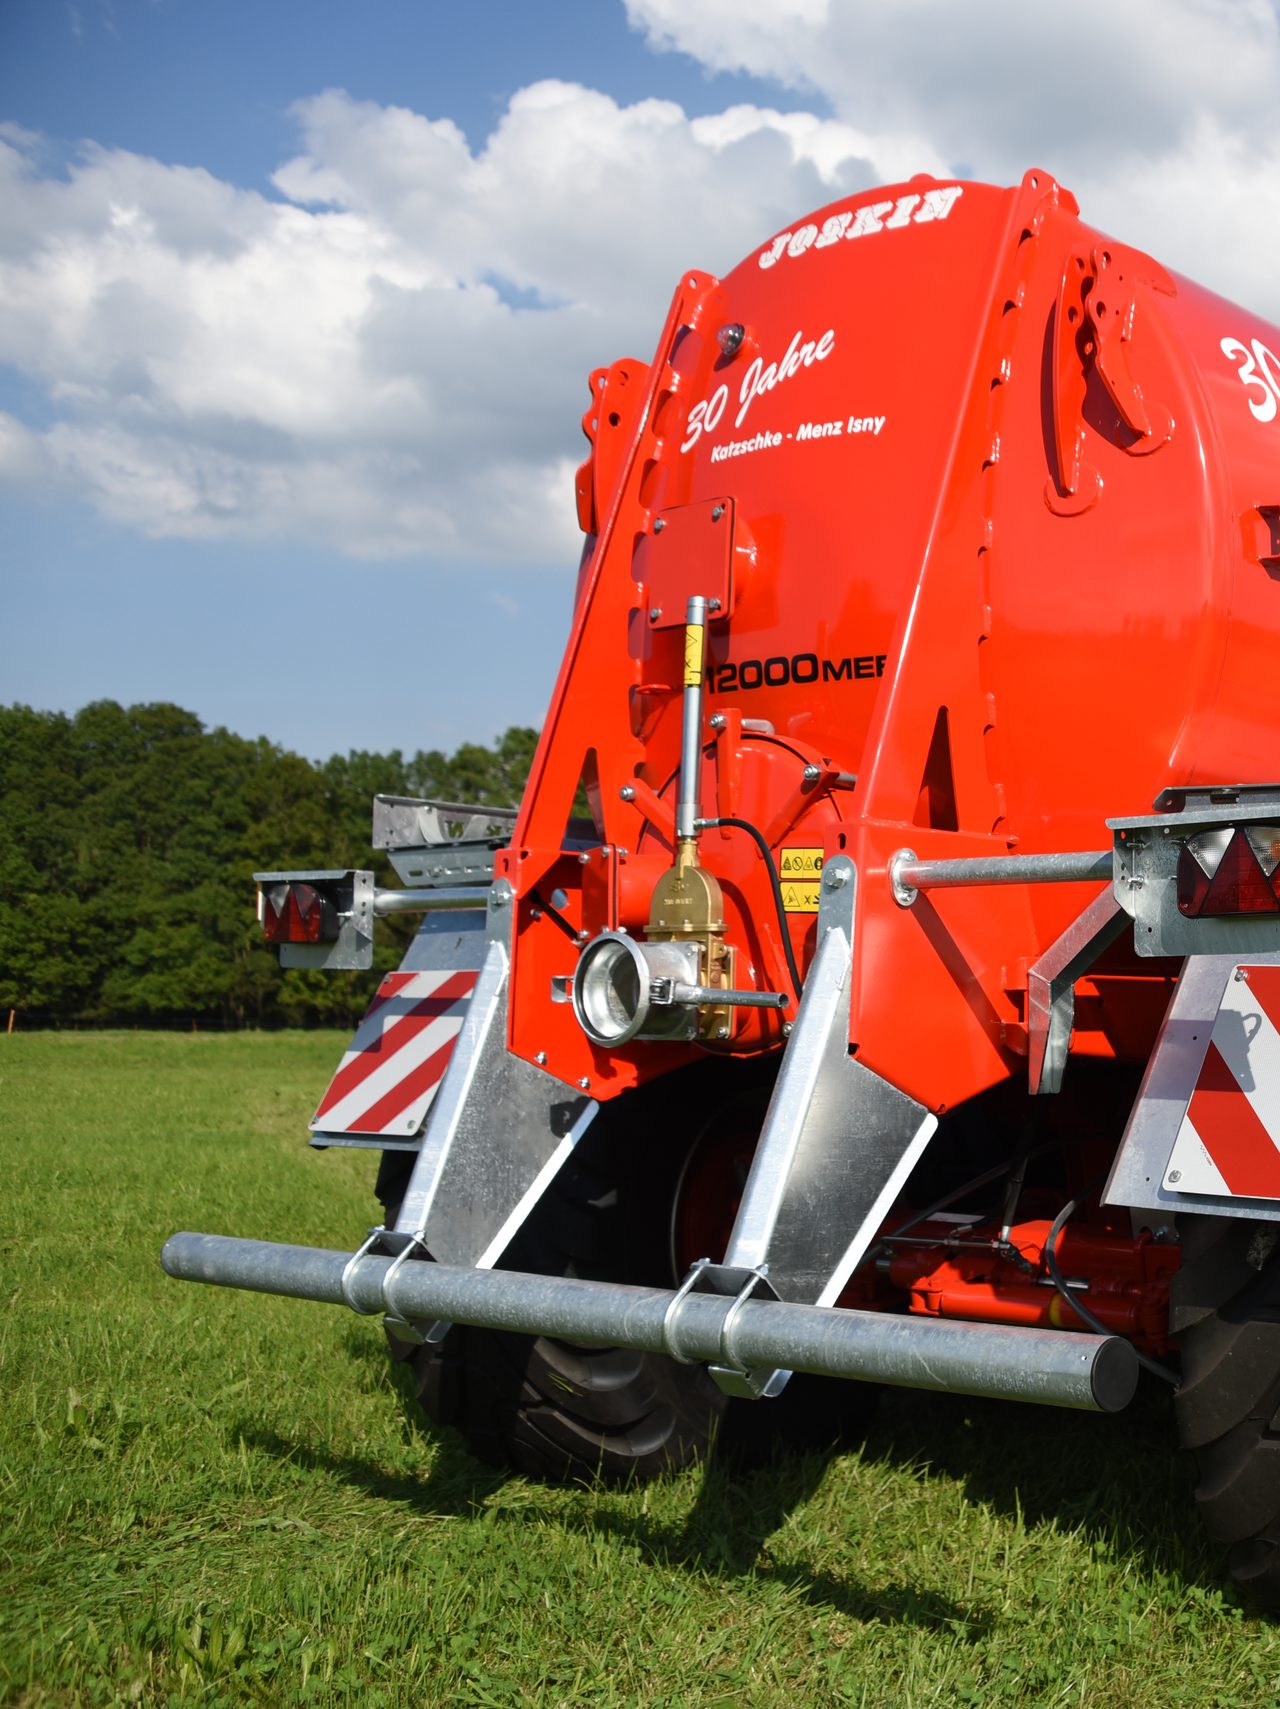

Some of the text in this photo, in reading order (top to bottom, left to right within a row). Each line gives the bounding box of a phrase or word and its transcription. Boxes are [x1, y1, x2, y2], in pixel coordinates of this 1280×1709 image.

[758, 186, 963, 269] JOSKIN
[680, 329, 835, 453] 30 Jahre
[711, 431, 782, 463] Katzschke
[796, 420, 843, 442] Menz
[847, 416, 886, 435] Isny
[706, 653, 818, 694] 12000
